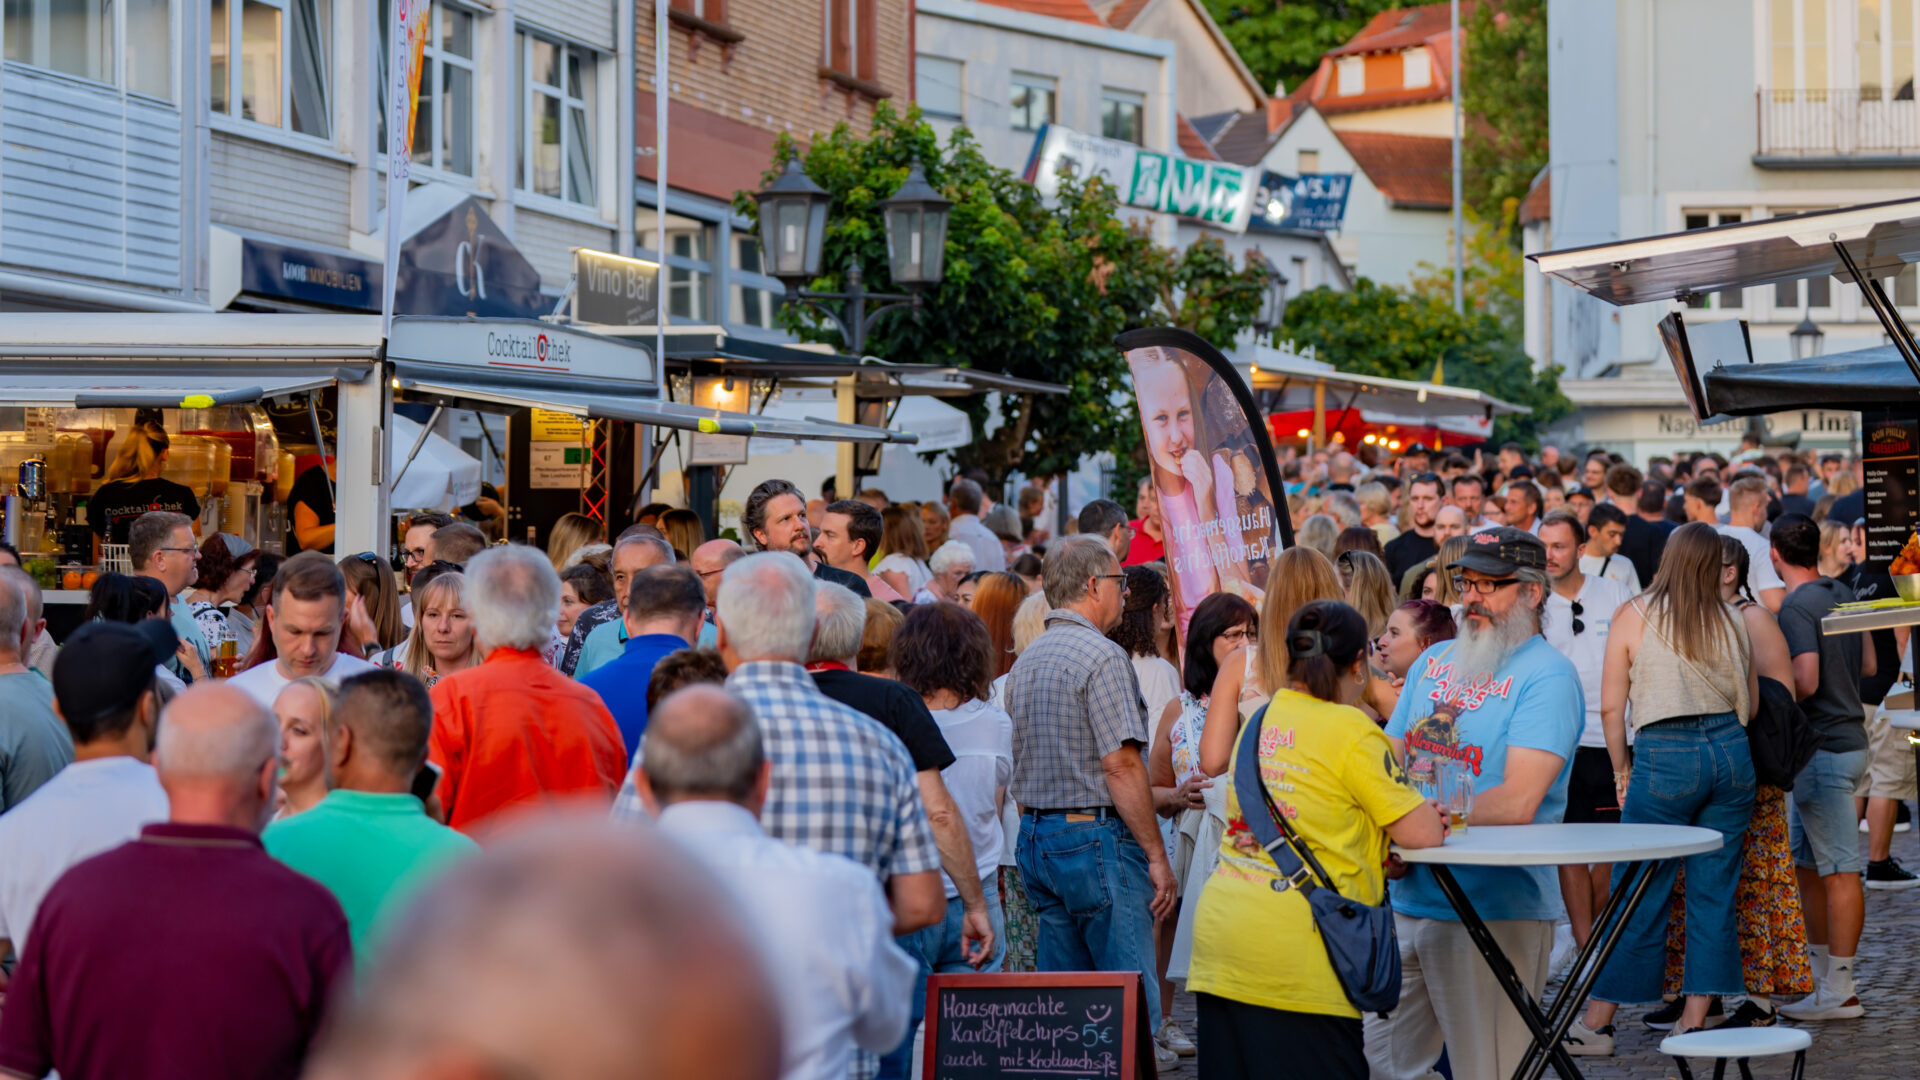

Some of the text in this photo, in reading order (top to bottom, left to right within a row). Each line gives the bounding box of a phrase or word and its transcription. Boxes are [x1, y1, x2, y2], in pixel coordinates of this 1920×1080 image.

[586, 256, 652, 302] Vino Bar
[1428, 680, 1488, 711] 2025
[1082, 1024, 1113, 1048] 5€
[943, 1049, 988, 1066] auch
[1000, 1049, 1024, 1067] mit
